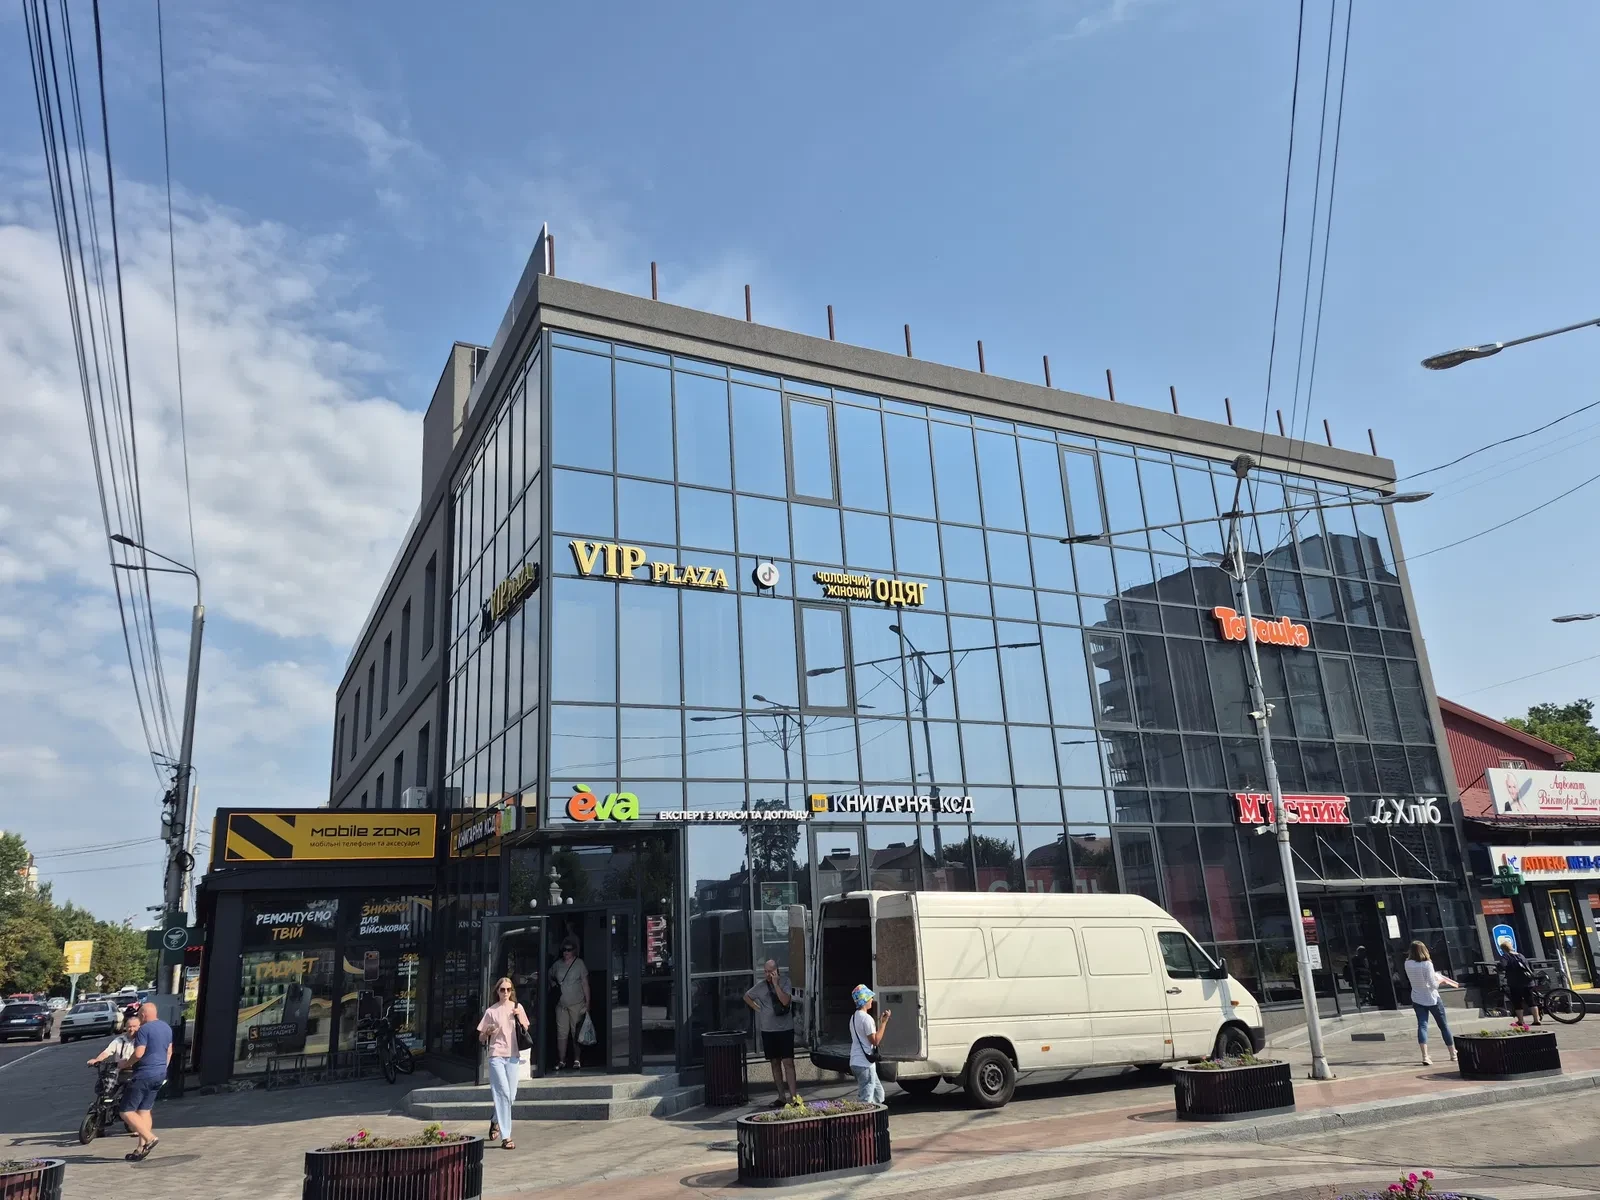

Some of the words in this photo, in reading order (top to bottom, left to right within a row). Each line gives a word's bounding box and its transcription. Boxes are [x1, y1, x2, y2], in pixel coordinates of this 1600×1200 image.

[569, 540, 647, 580] VIP
[651, 562, 729, 590] PLAZA
[816, 571, 872, 587] ЧОЛОВІЧИЙ
[826, 583, 873, 600] ЖІНОЧИЙ
[876, 578, 929, 607] ОДЯГ
[832, 794, 932, 812] КНИГАРНЯ
[939, 796, 975, 813] КСД
[1537, 789, 1579, 811] Вікторія
[658, 811, 706, 820] ЕКСПЕРТ
[715, 811, 748, 820] КРАСИ
[749, 811, 762, 820] ТА
[763, 811, 810, 820] ДОГЛЯДУ
[1391, 797, 1442, 824] Хліб
[342, 840, 376, 848] телефони
[386, 840, 420, 848] аксесуари
[1521, 856, 1567, 871] АПТЕКА
[256, 910, 332, 926] РЕМОНТУЄМО
[361, 903, 410, 917] ЗНИЖКИ
[360, 915, 380, 925] ДЛЯ
[272, 924, 304, 940] ТВІЙ
[360, 923, 410, 935] ВІЙСЬКОВИХ
[255, 957, 320, 977] ГАДЖЕТ
